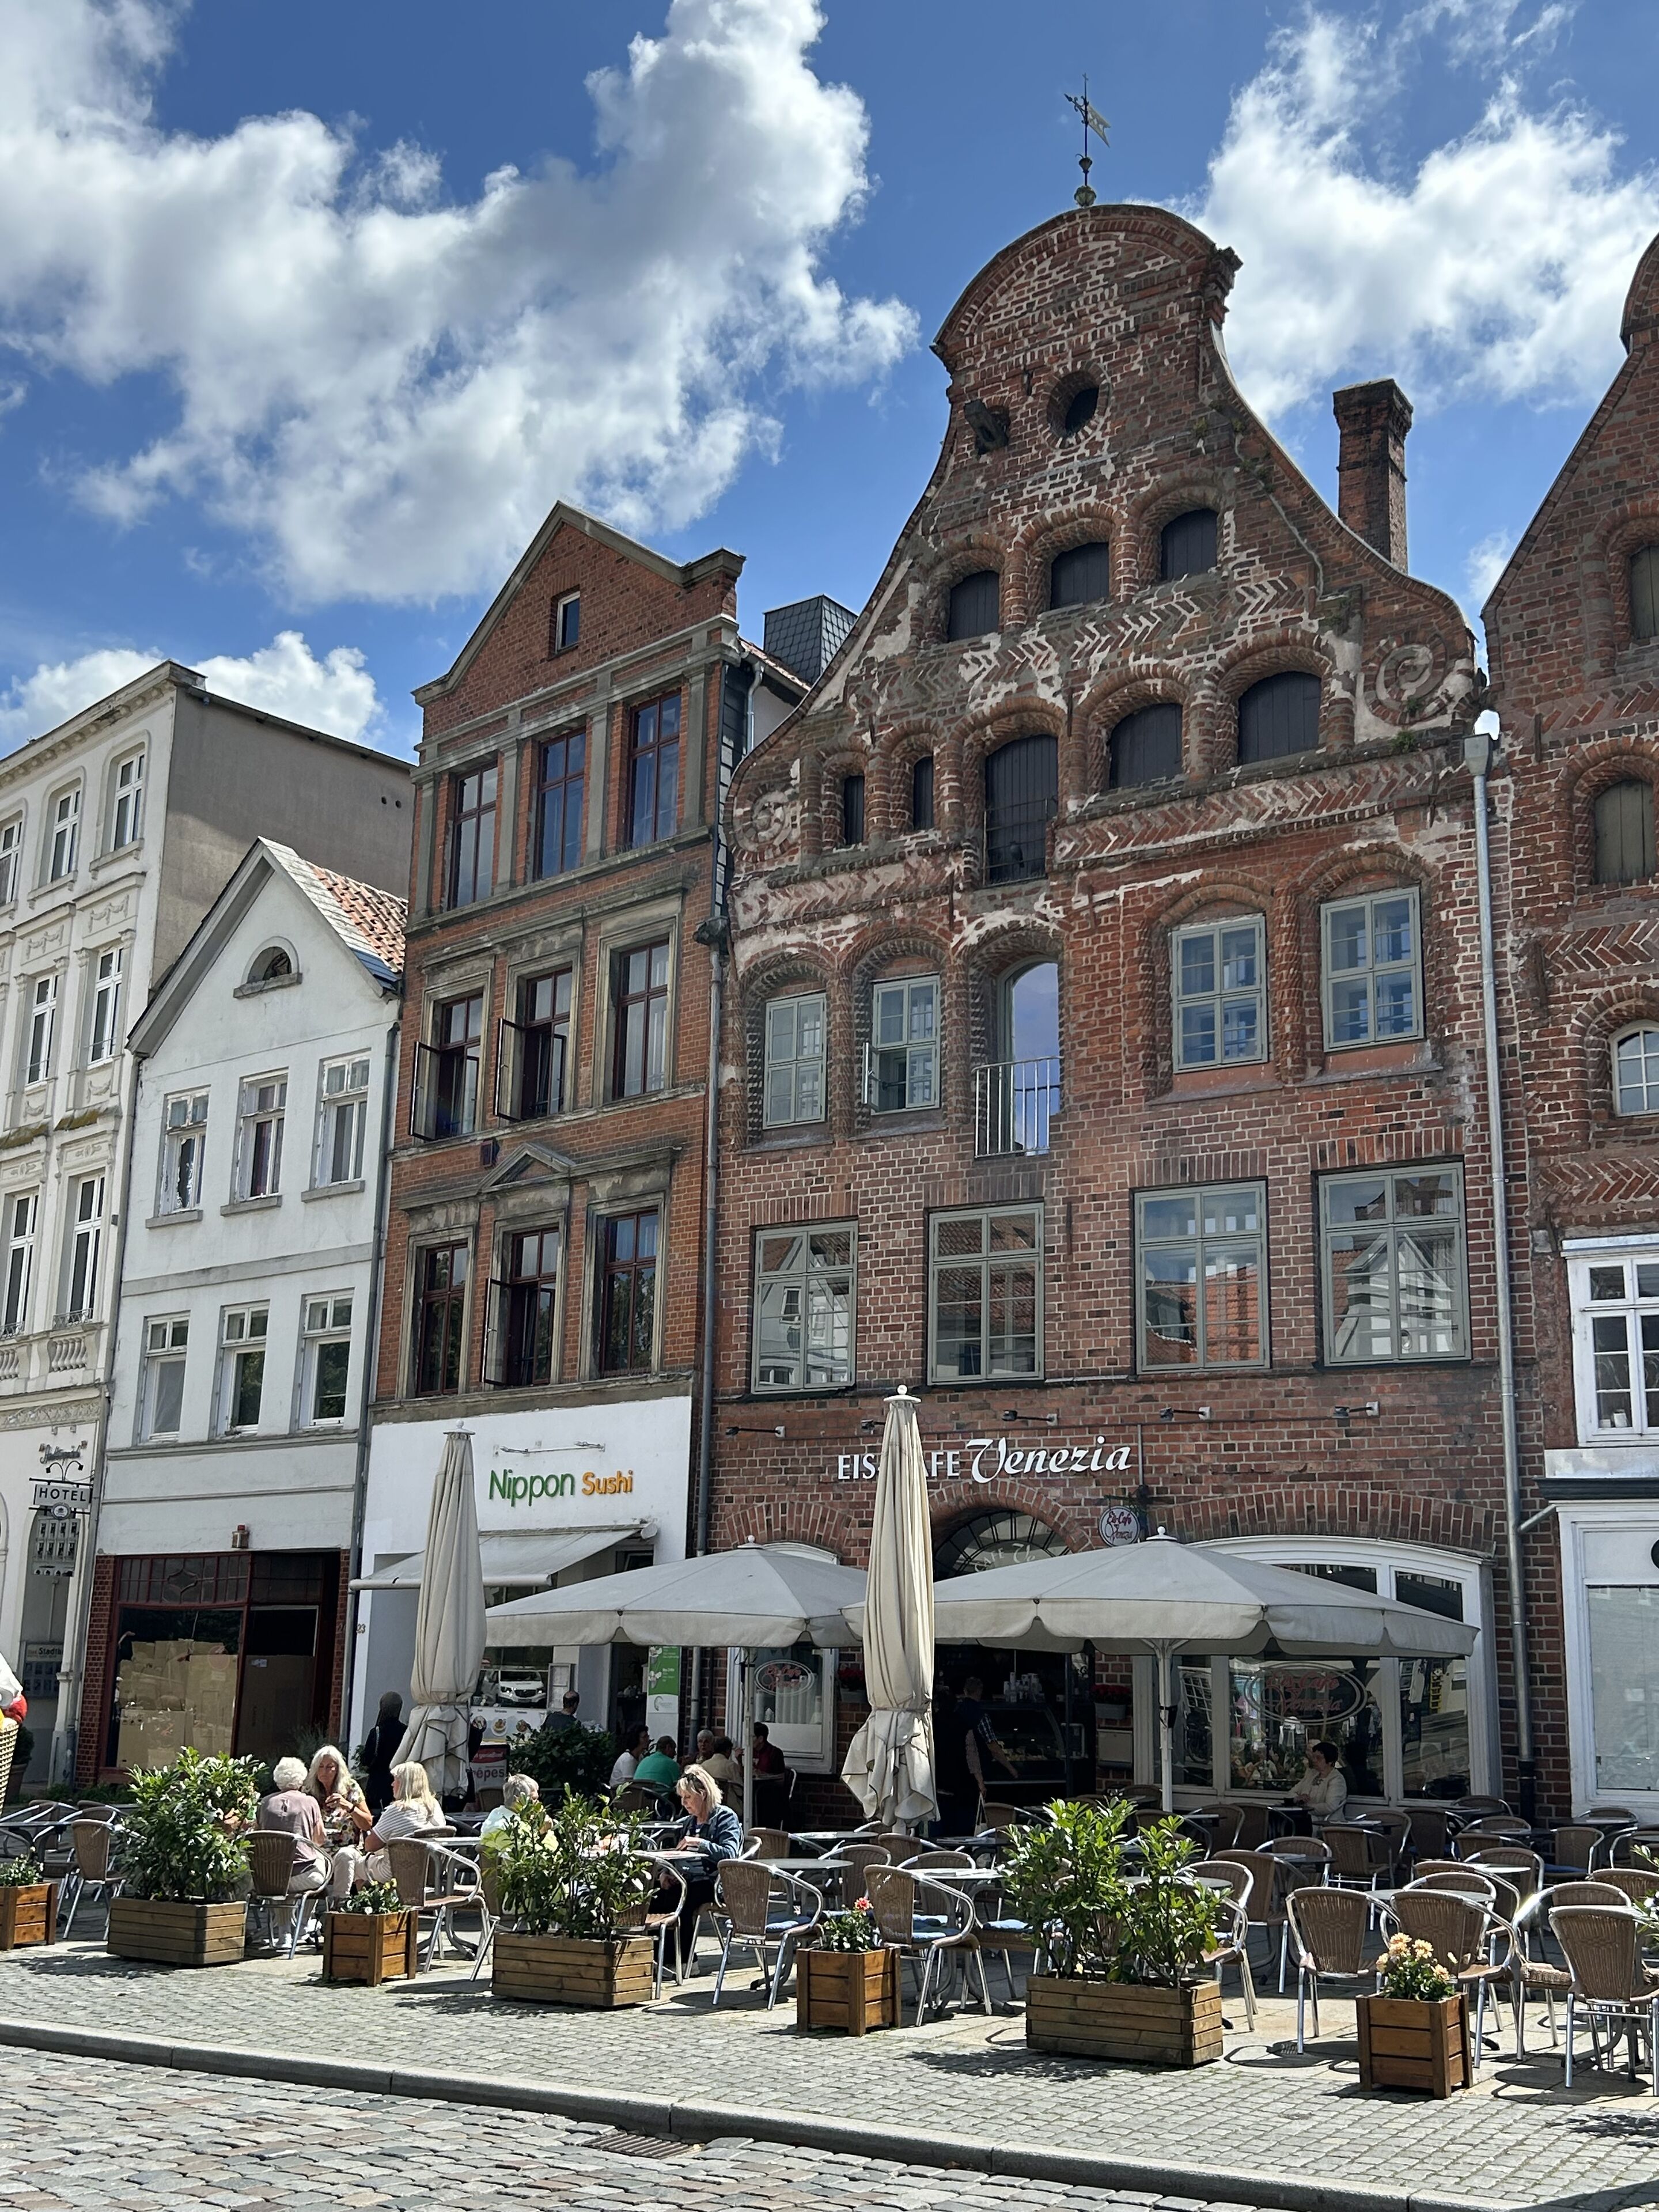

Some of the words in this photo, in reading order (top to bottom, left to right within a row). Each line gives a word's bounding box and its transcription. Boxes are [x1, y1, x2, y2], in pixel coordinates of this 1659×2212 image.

[967, 1435, 1132, 1483] Venezia
[39, 1487, 86, 1502] HOTEL
[490, 1469, 575, 1507] Nippon
[582, 1470, 633, 1496] Sushi
[356, 1623, 366, 1634] 23
